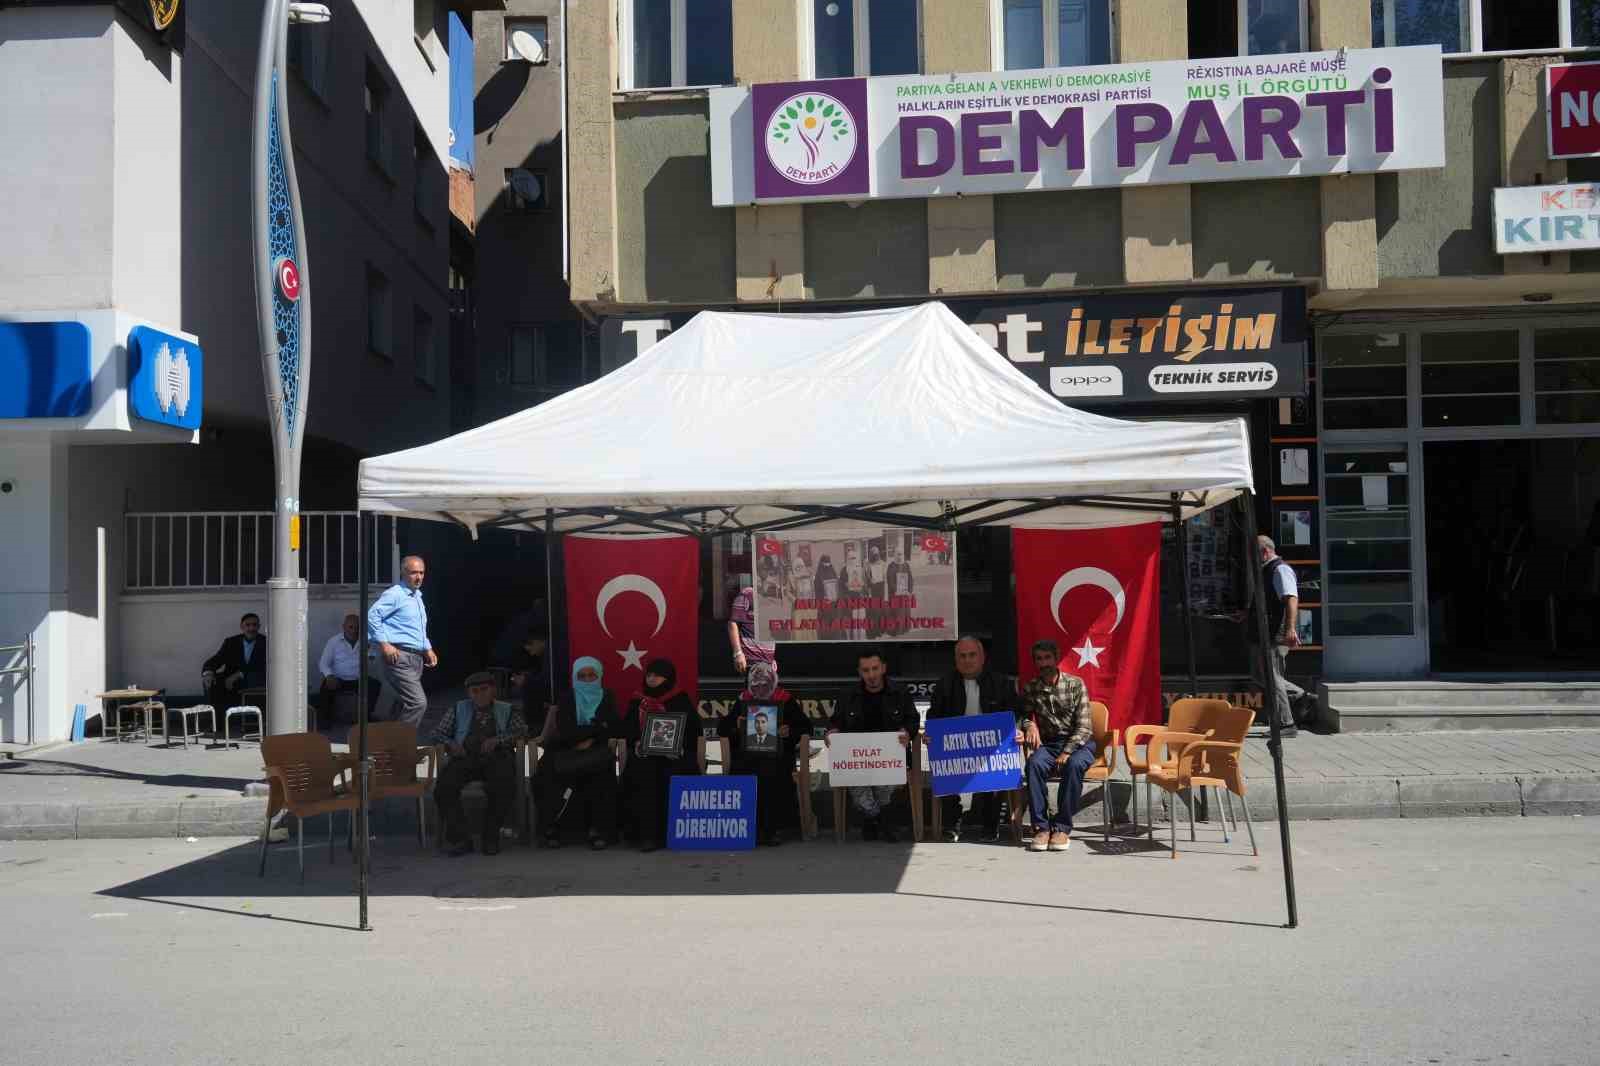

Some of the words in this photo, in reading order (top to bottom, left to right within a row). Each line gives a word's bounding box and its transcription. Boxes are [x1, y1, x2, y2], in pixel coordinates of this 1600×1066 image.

[945, 82, 985, 94] GELAN
[989, 81, 997, 92] A
[1187, 84, 1230, 99] MUŞ
[1238, 79, 1254, 96] İL
[1262, 74, 1347, 94] ÖRGÜTÜ
[897, 99, 965, 112] HALKLARIN
[968, 95, 1011, 110] EŞİTLİK
[1014, 95, 1029, 106] VE
[1033, 91, 1100, 105] DEMOKRASİ
[1105, 87, 1152, 101] PARTİSİ
[1560, 89, 1600, 128] N
[899, 106, 1085, 179] DEM
[1115, 67, 1395, 168] PARTİ
[785, 166, 807, 180] DEM
[1065, 303, 1277, 362] İLETİŞİM
[1060, 375, 1112, 386] oppo
[1153, 370, 1213, 385] TEKNİK
[1217, 367, 1273, 383] SERVİS
[970, 730, 997, 748] YETER
[852, 749, 881, 758] EVLAT
[833, 759, 903, 769] NÖBETİNDEYİZ
[680, 789, 741, 810] ANNELER
[676, 813, 748, 839] DİRENİYOR
